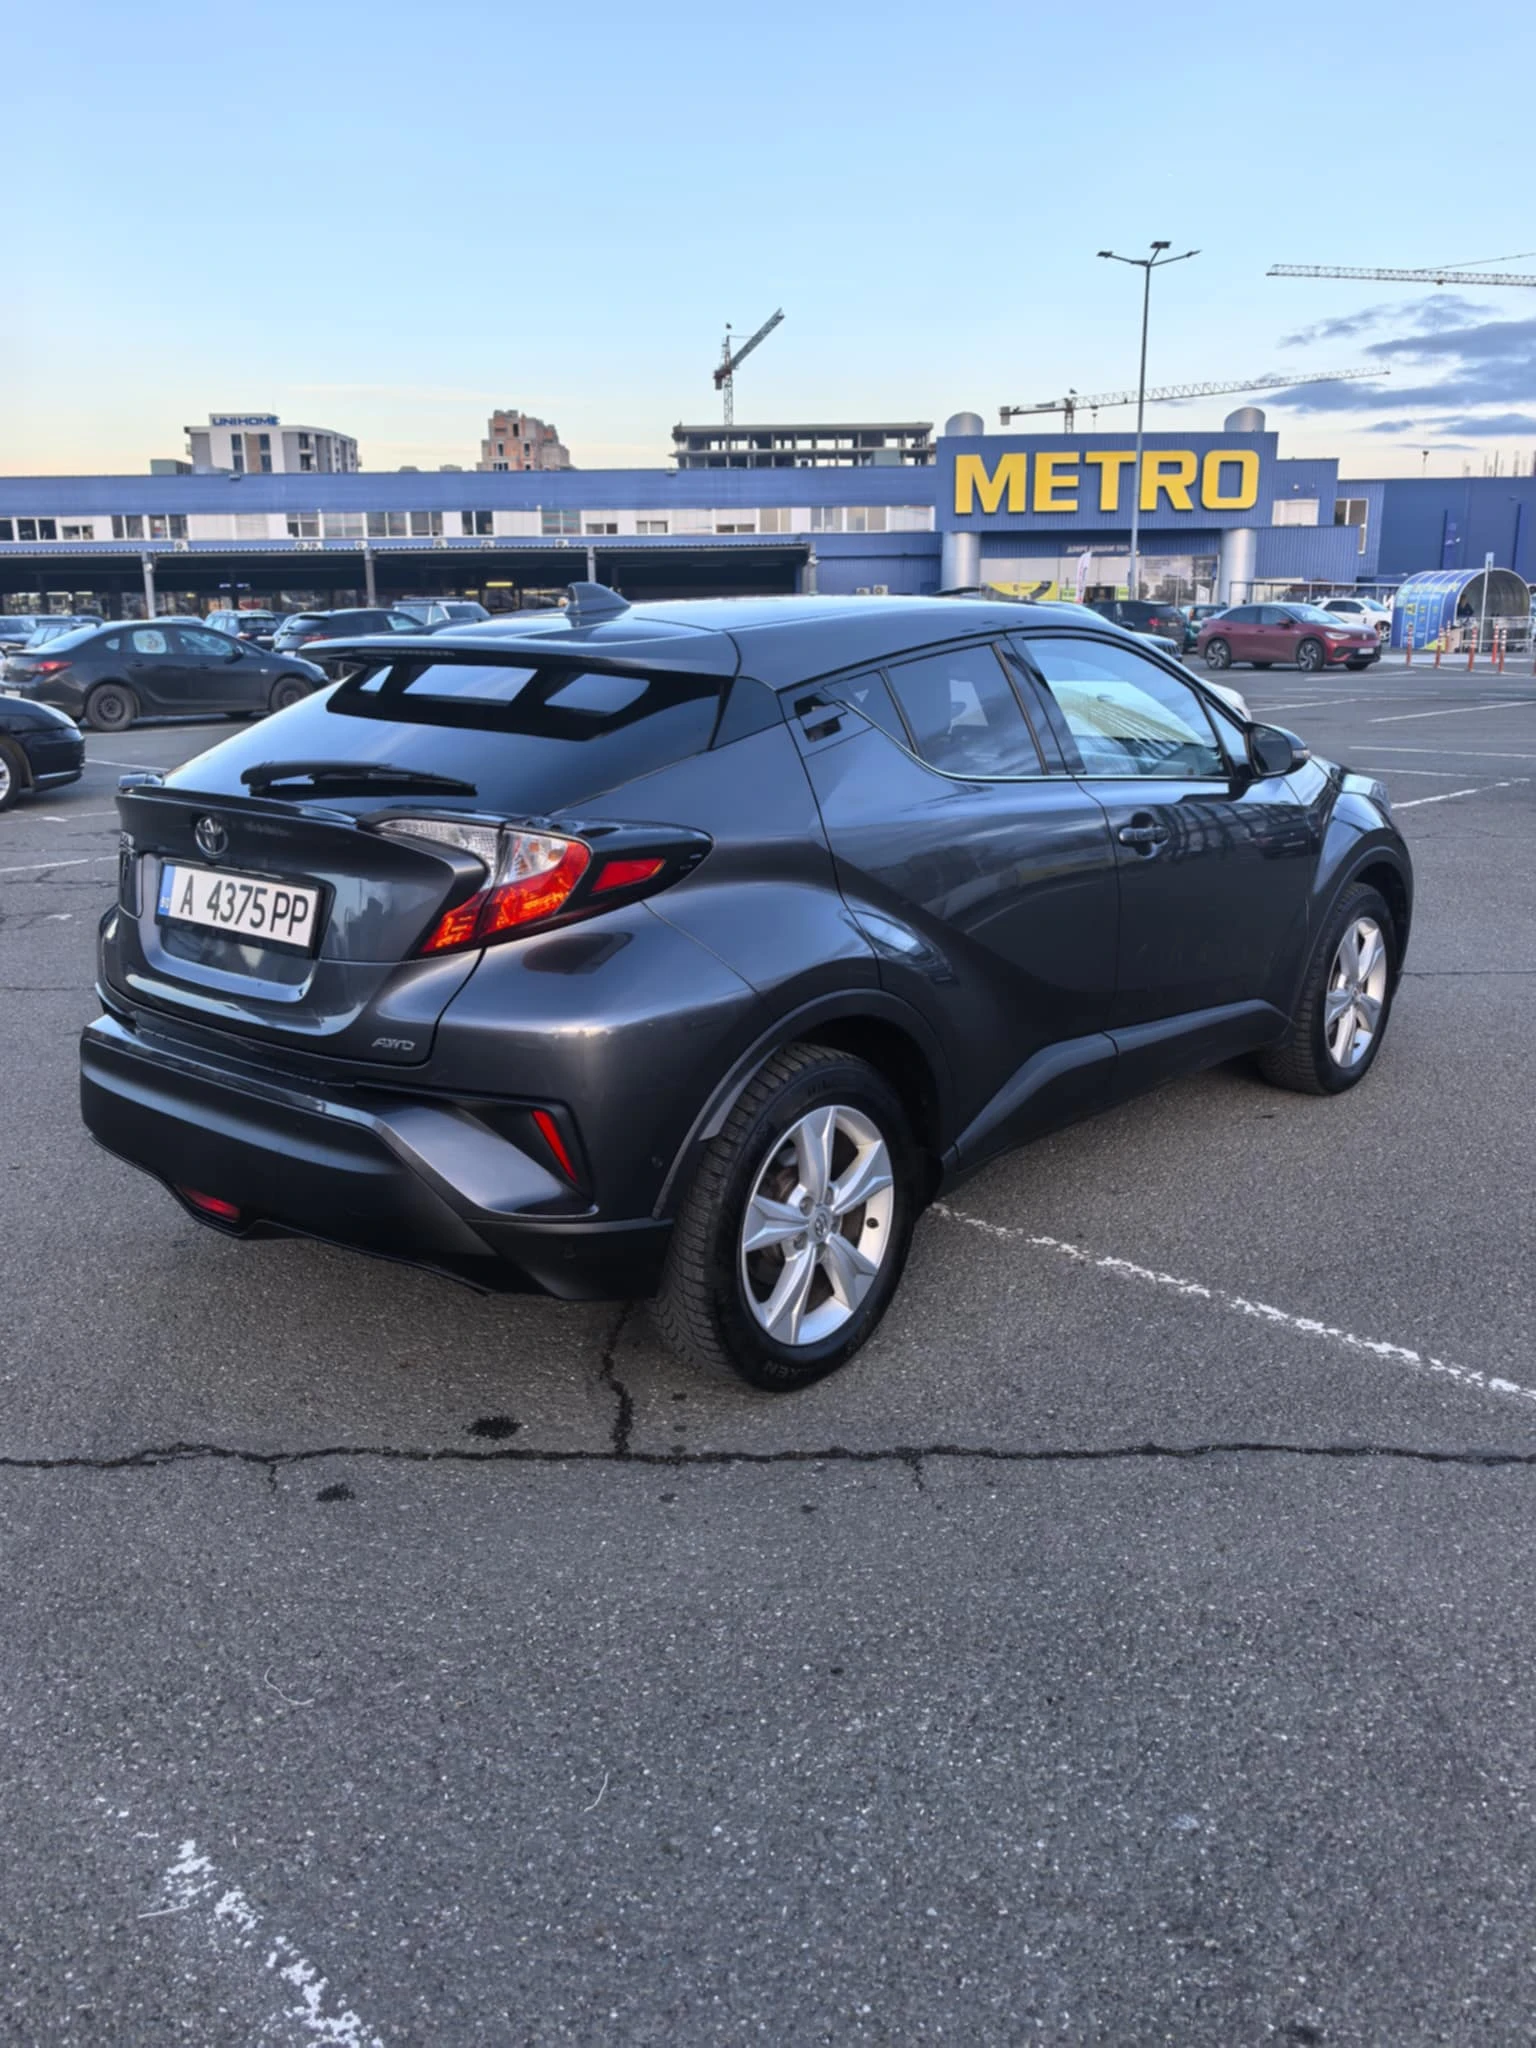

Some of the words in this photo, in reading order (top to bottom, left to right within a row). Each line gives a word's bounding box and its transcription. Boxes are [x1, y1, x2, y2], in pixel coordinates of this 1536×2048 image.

[212, 415, 280, 427] UNIHOME
[955, 449, 1259, 514] METRO
[180, 874, 193, 915] A
[206, 879, 268, 929] 4375
[270, 891, 309, 937] PP
